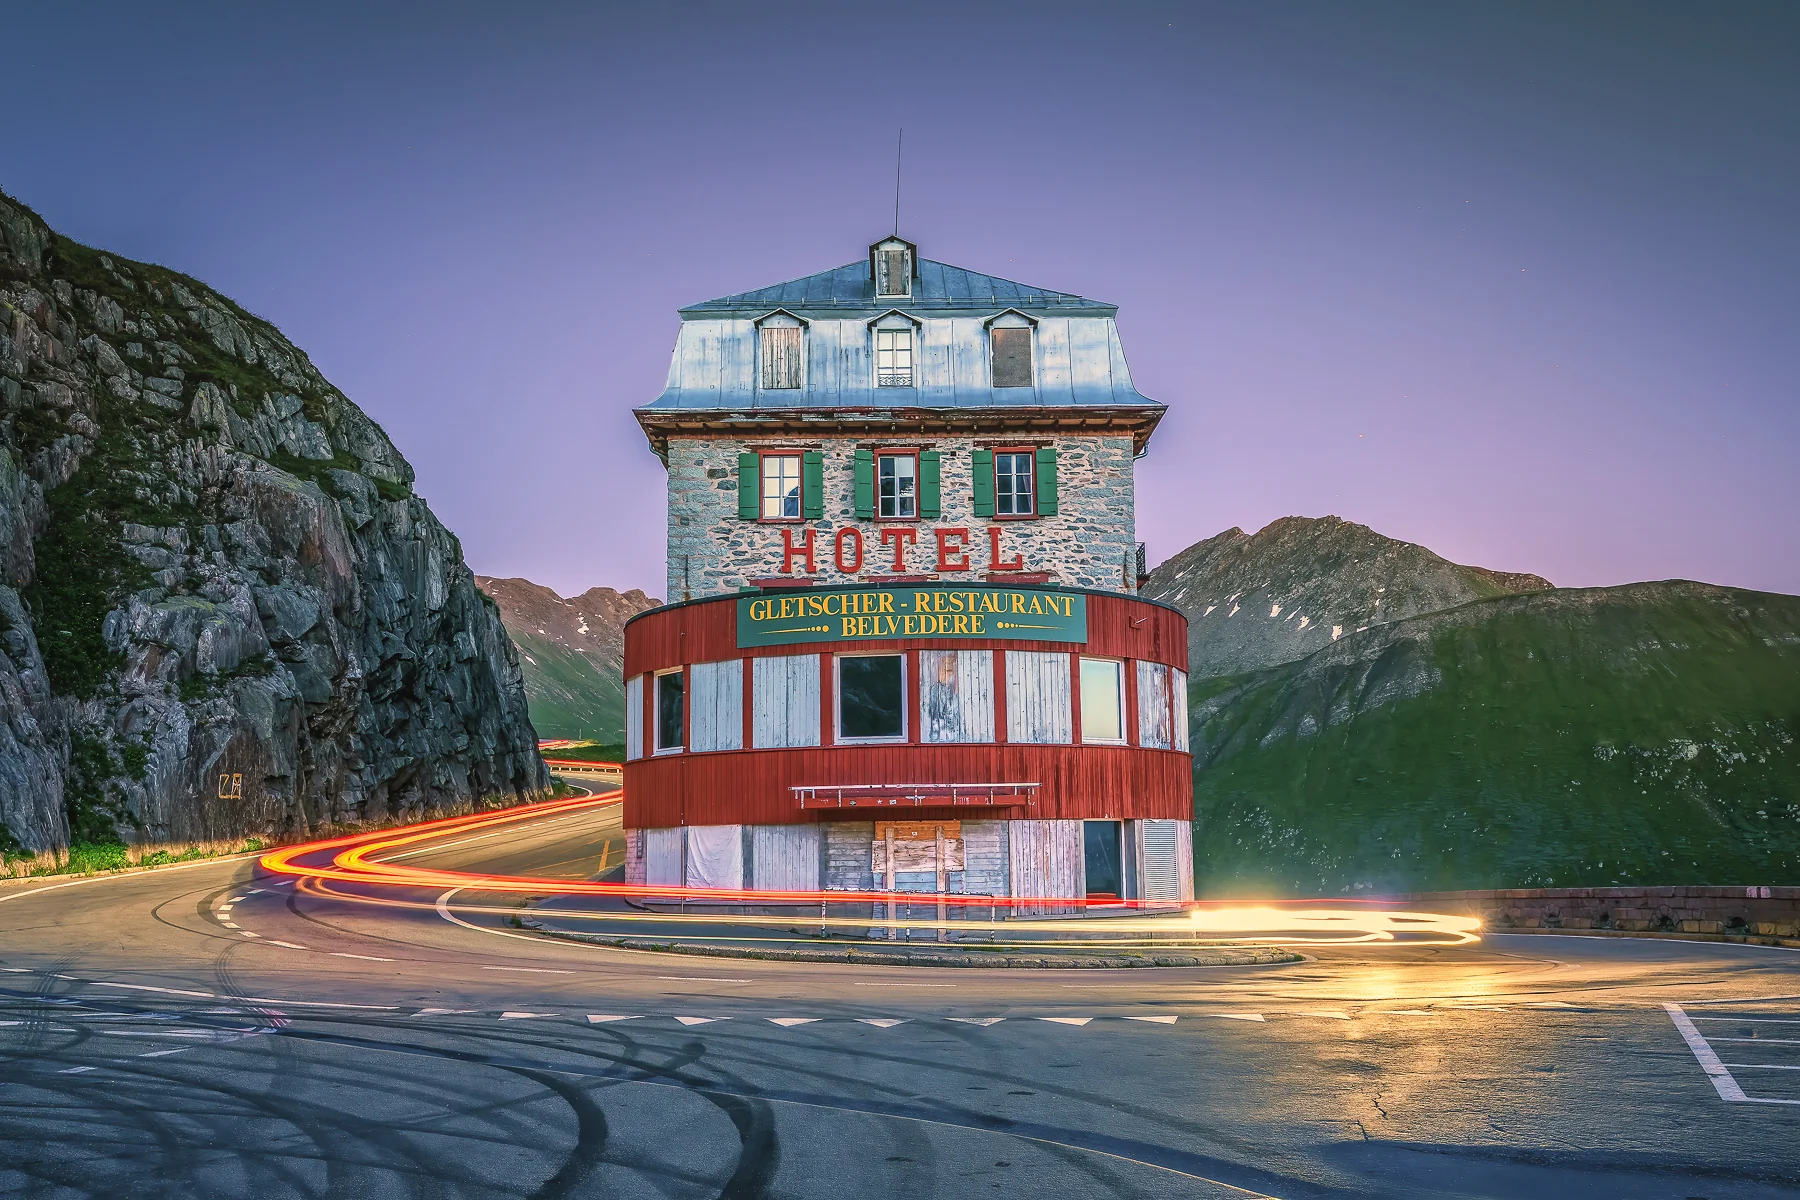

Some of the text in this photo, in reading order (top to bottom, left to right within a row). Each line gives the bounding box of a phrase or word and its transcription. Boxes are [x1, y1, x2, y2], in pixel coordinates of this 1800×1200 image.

[781, 527, 1024, 573] HOTEL
[749, 592, 895, 621] GLETSCHER
[915, 591, 1076, 617] RESTAURANT
[841, 614, 987, 637] BELVEDERE
